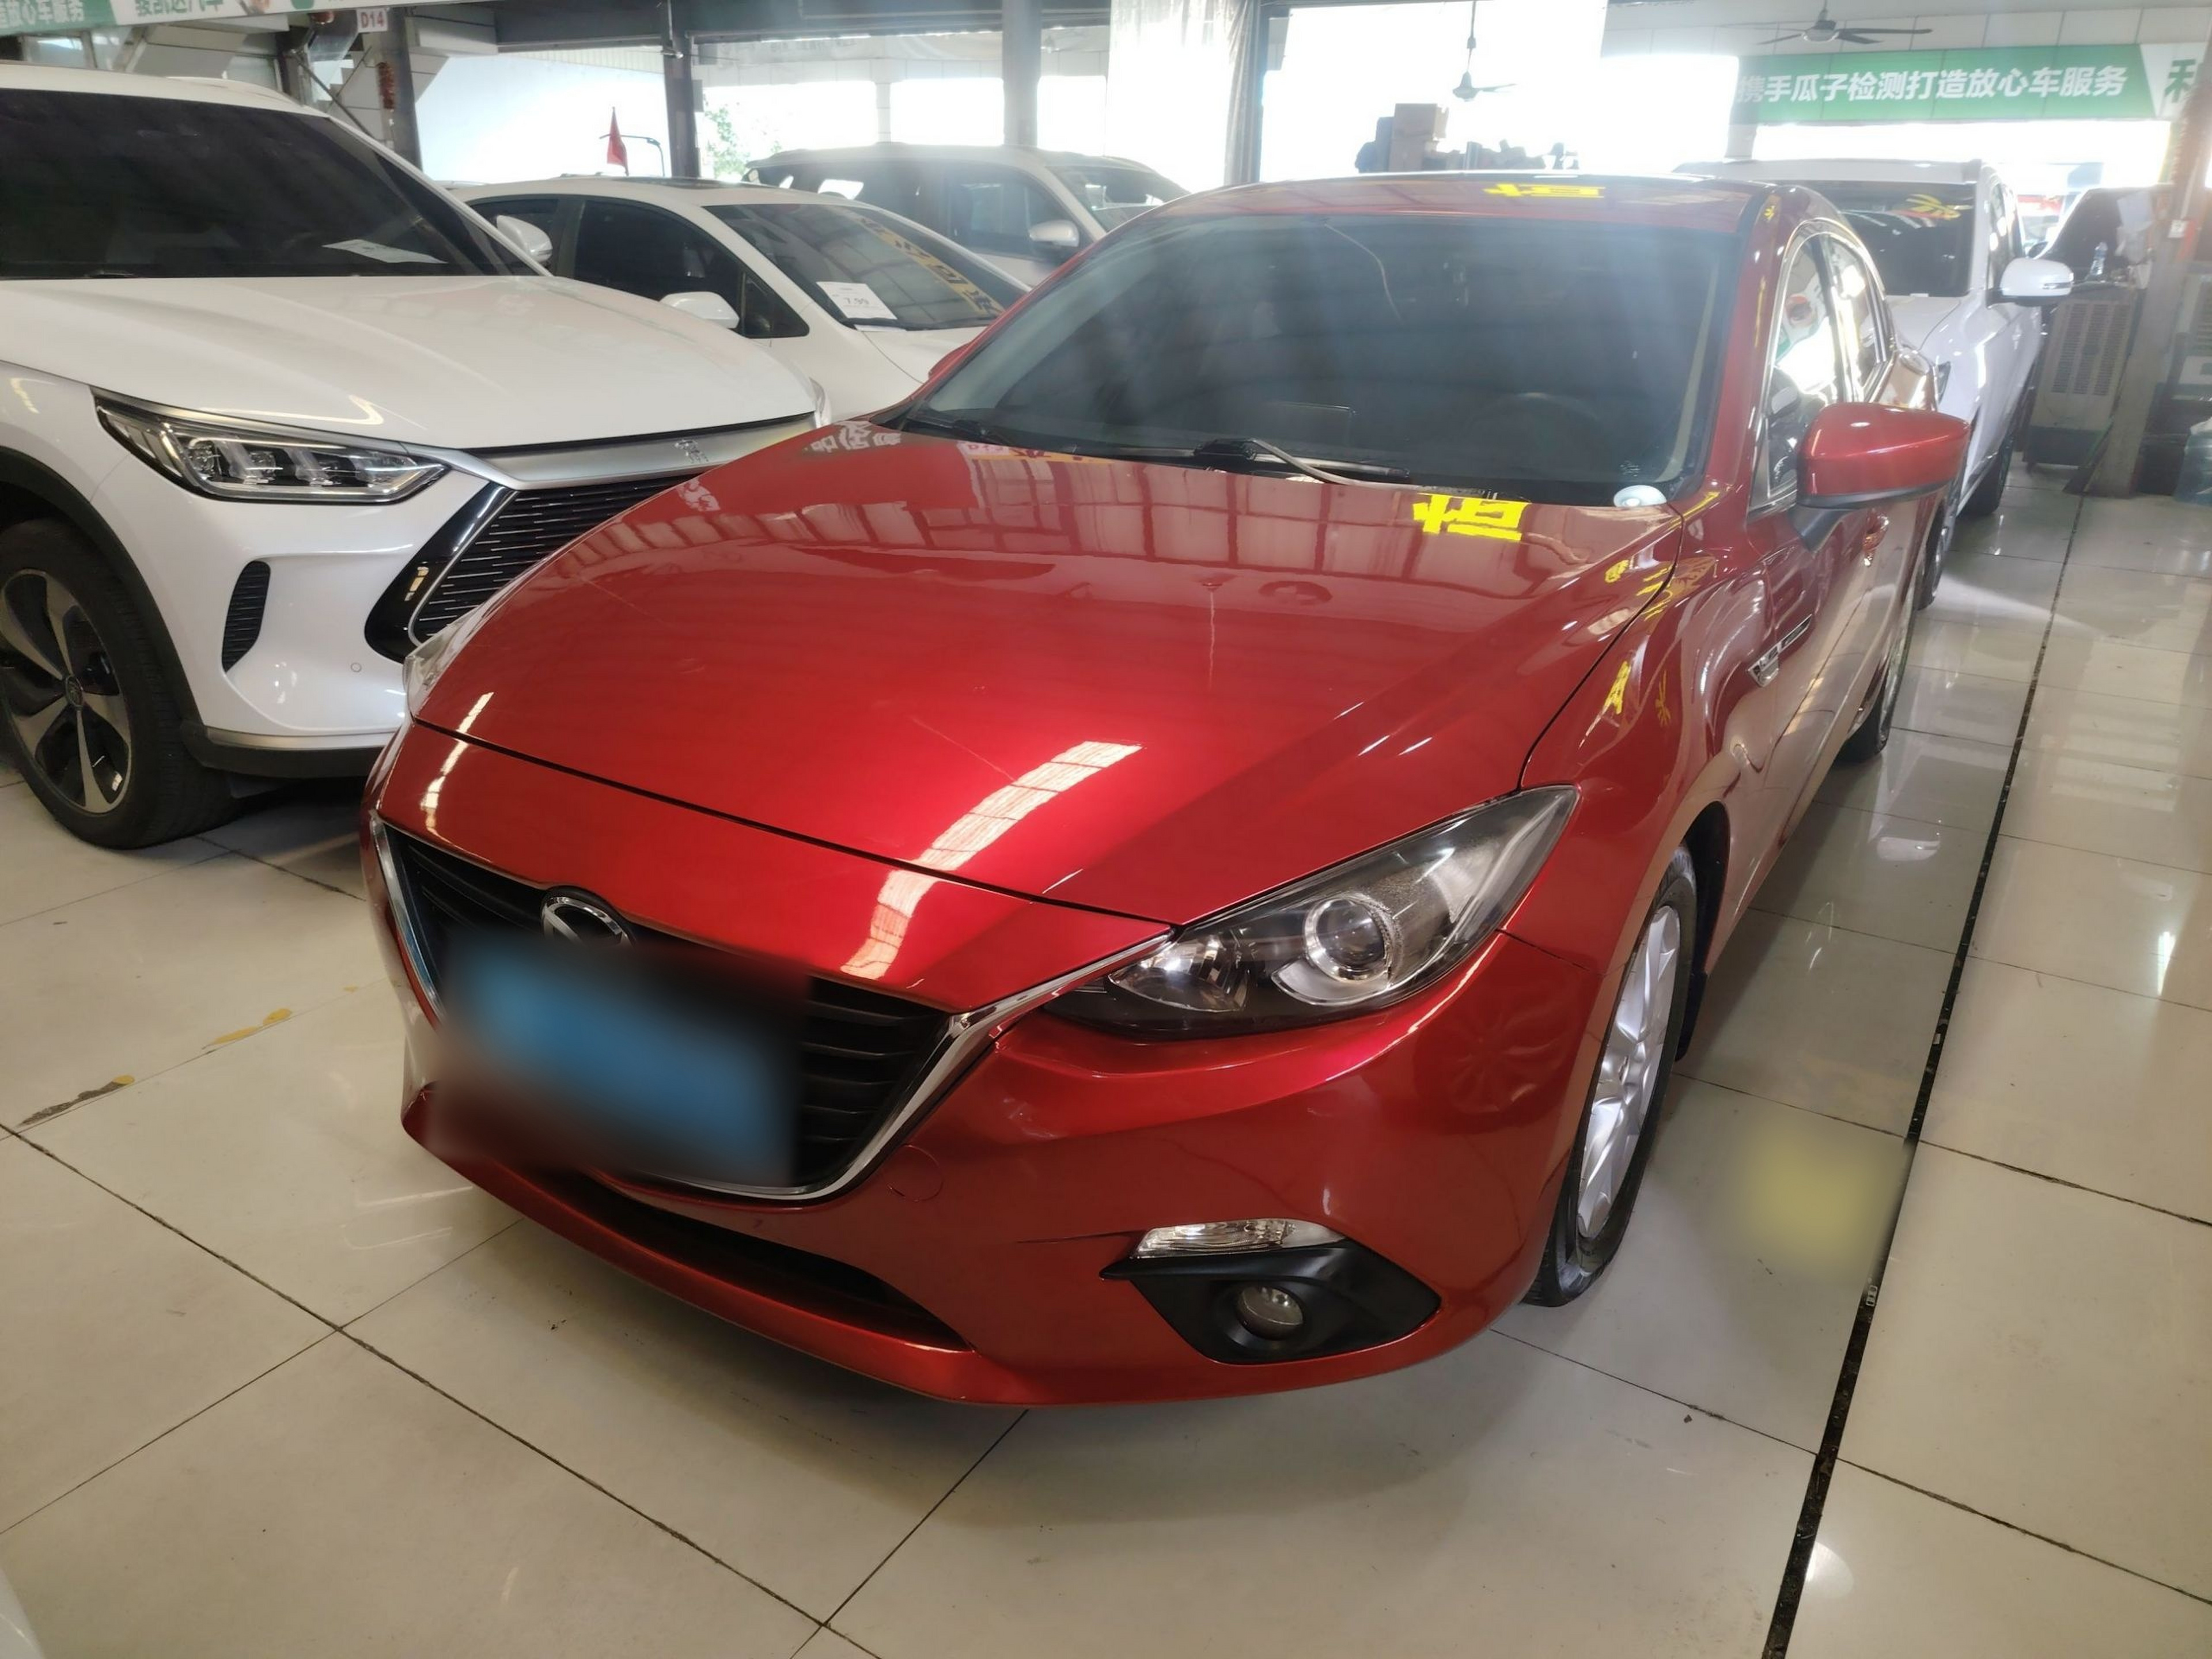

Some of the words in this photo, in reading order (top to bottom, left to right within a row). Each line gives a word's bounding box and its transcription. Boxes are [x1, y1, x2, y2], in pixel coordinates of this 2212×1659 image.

[360, 11, 385, 28] D14
[1736, 65, 2128, 103] 携手瓜子检测打造放心车服务
